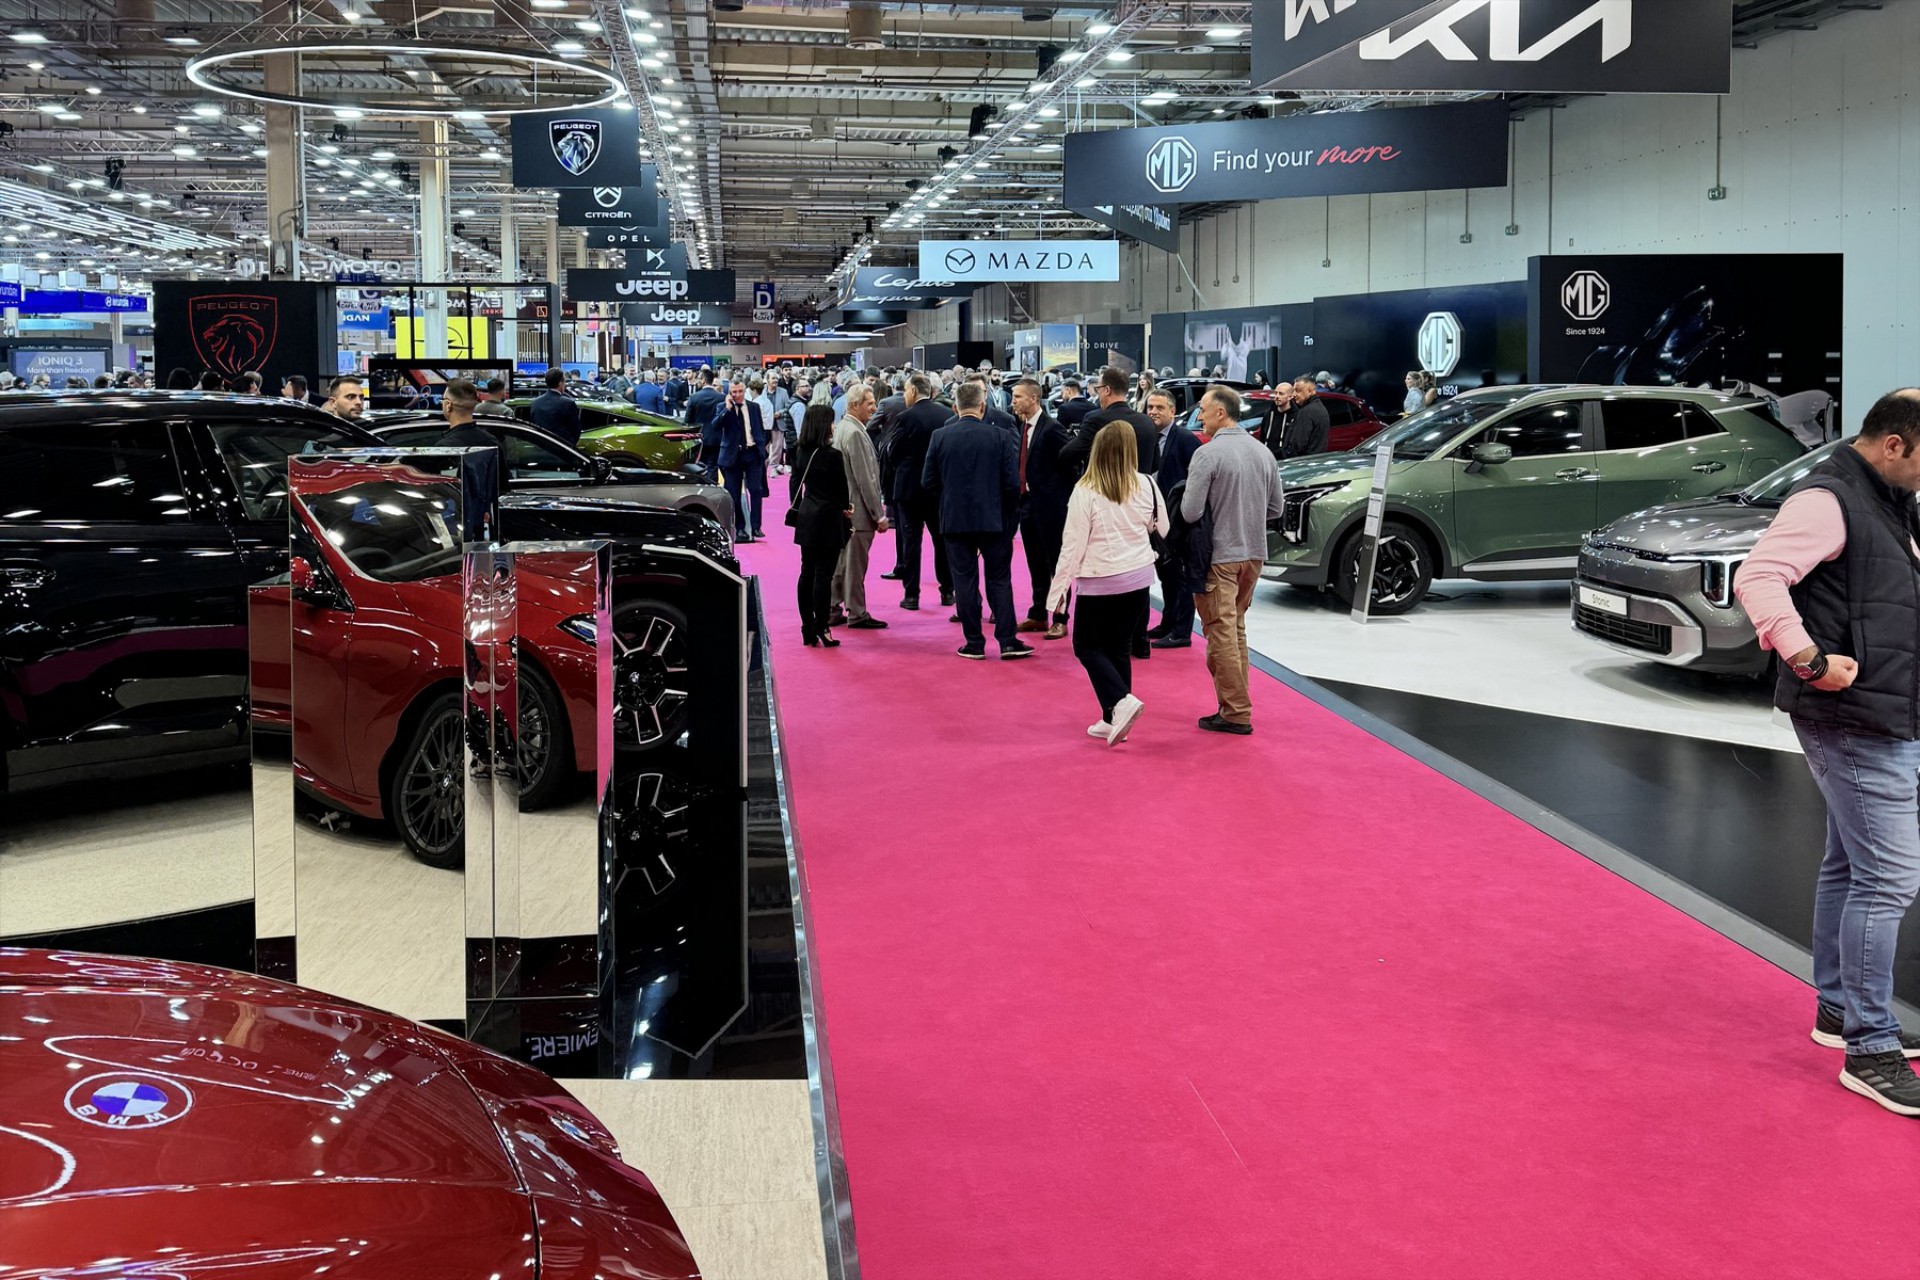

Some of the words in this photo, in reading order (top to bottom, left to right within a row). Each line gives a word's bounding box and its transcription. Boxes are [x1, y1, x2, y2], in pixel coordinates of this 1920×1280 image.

[553, 123, 598, 131] PEUGEOT
[1149, 140, 1194, 189] MG
[1213, 149, 1258, 172] Find
[1264, 150, 1313, 174] your
[1316, 143, 1401, 166] more
[607, 234, 650, 243] OPEL
[988, 252, 1094, 270] MAZDA
[615, 279, 688, 300] Jeep
[1565, 274, 1606, 317] MG
[196, 302, 270, 311] PEUGEOT
[756, 290, 771, 309] D
[650, 304, 700, 325] Jeep
[1565, 327, 1587, 336] Since
[1588, 327, 1606, 335] 1924
[1052, 341, 1076, 350] MADE
[1079, 341, 1091, 350] TO
[1093, 341, 1120, 350] DRIVE
[1421, 317, 1454, 372] MG
[27, 364, 45, 374] More
[46, 364, 63, 374] than
[64, 363, 95, 374] freedom
[38, 355, 74, 366] IONIQ
[75, 355, 83, 366] 3
